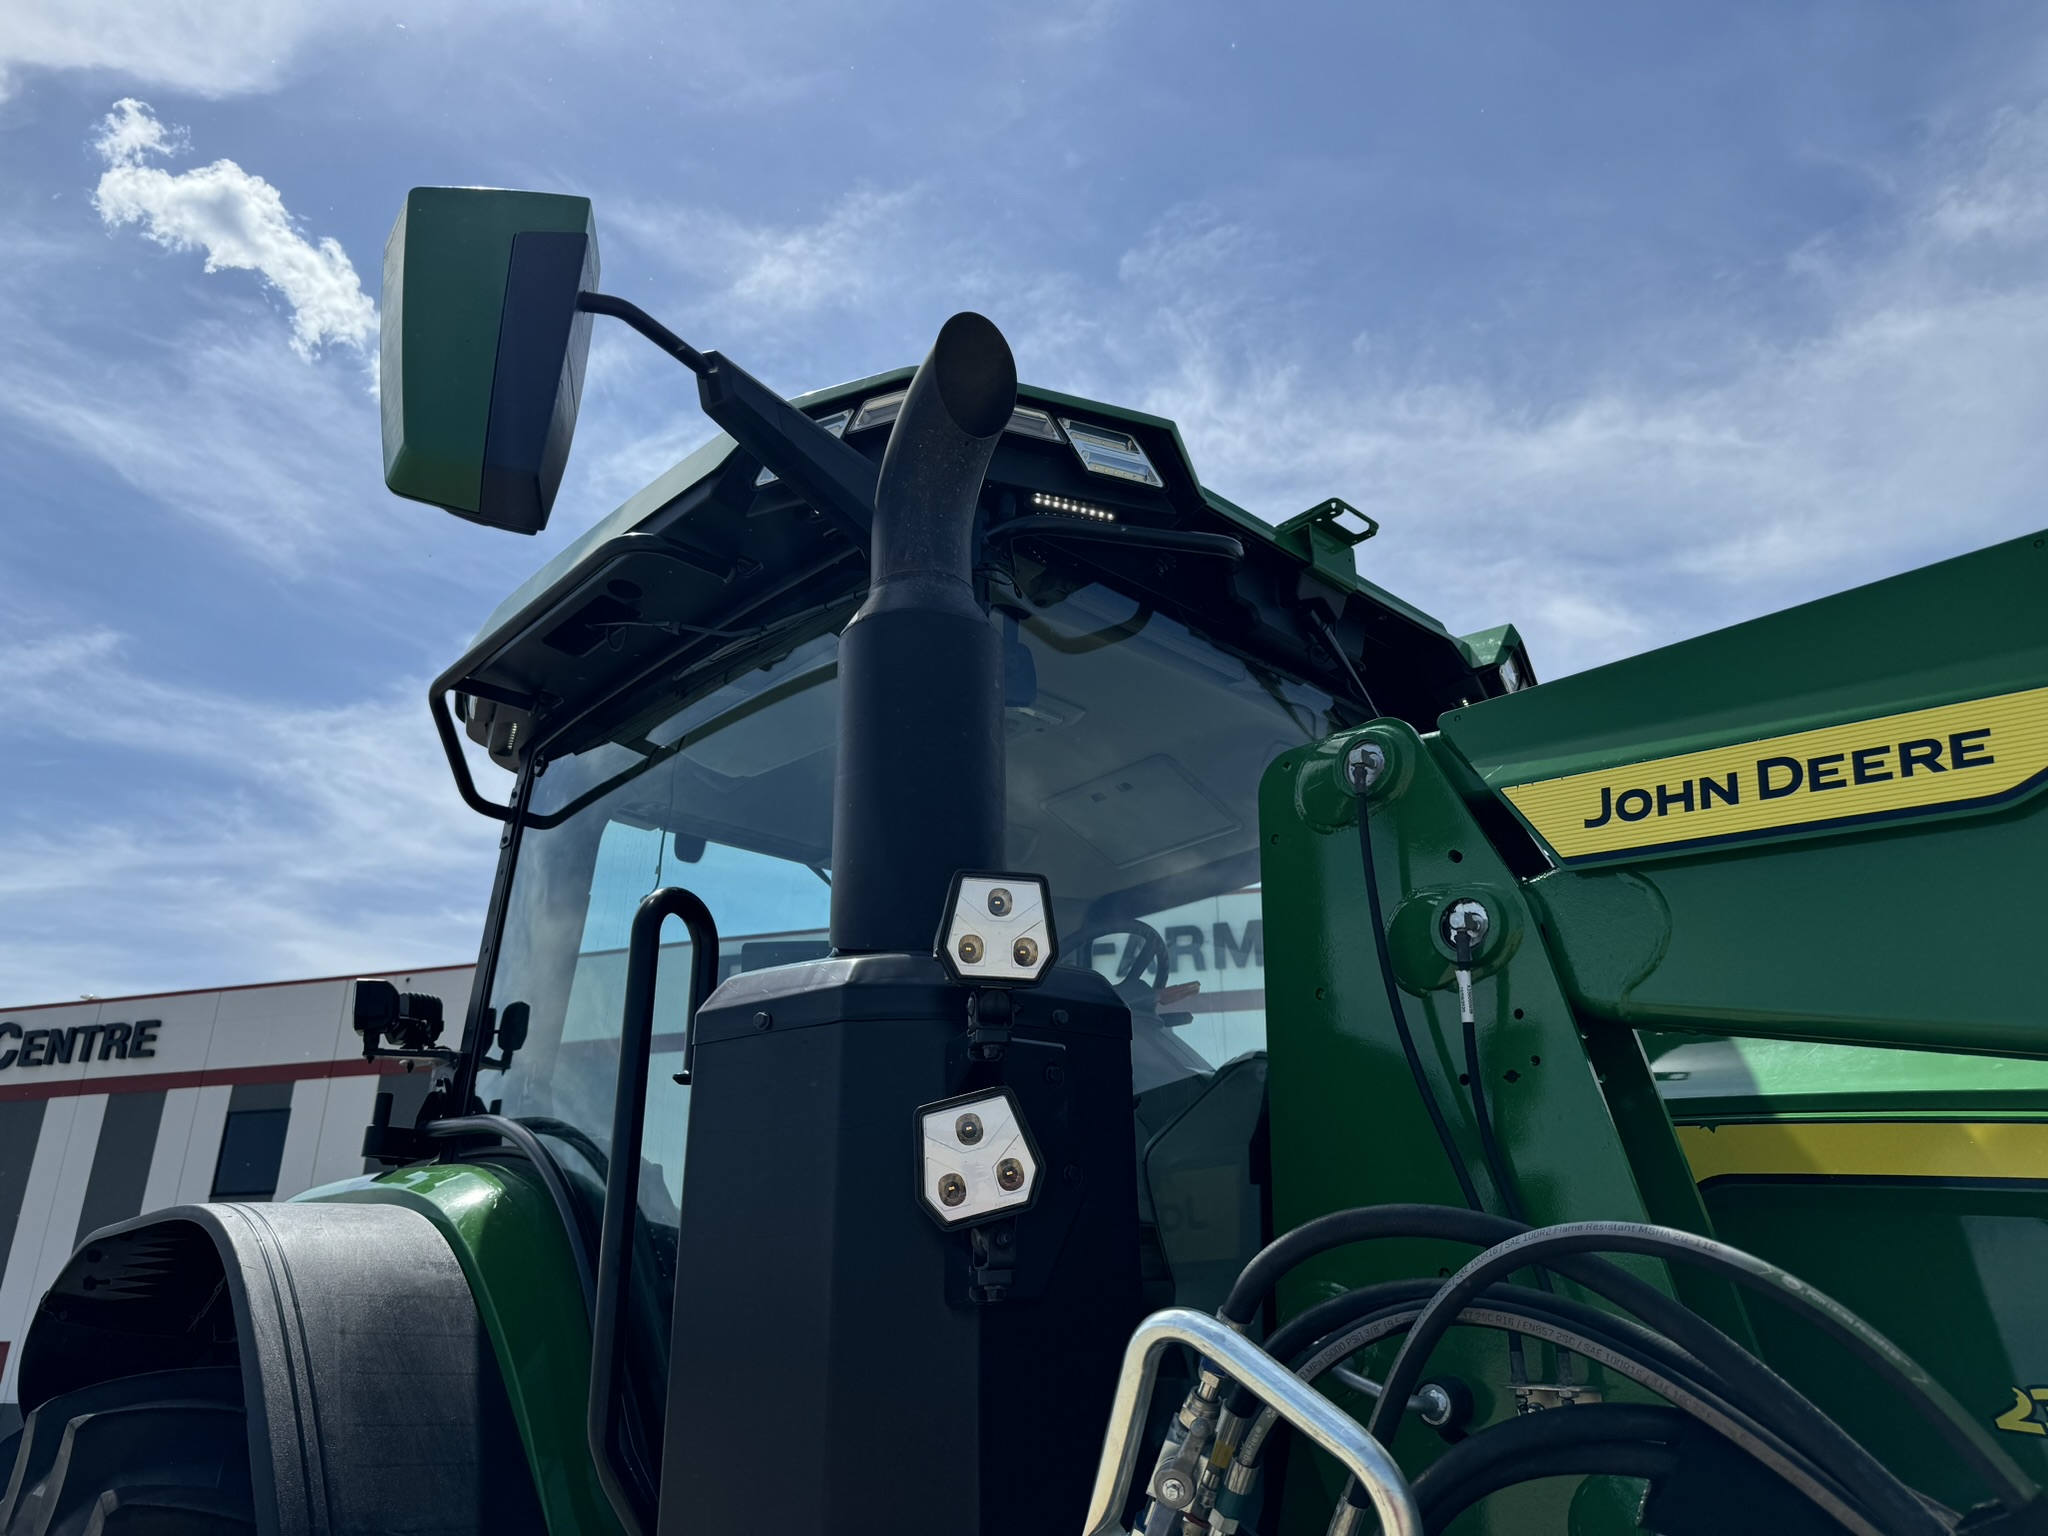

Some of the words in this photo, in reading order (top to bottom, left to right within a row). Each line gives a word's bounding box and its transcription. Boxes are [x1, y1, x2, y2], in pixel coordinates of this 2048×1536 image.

[1584, 772, 1739, 828] JOHN
[1757, 728, 1995, 801] DEERE
[0, 1019, 162, 1070] CENTRE
[1504, 1238, 1521, 1250] SAE
[1523, 1228, 1552, 1242] 100R2
[1553, 1223, 1584, 1235] Flame
[1585, 1221, 1636, 1233] Resistant
[1637, 1224, 1672, 1241] MSHA
[1494, 1314, 1515, 1327] R16
[1522, 1320, 1555, 1338] EN857
[1583, 1342, 1602, 1357] SAE
